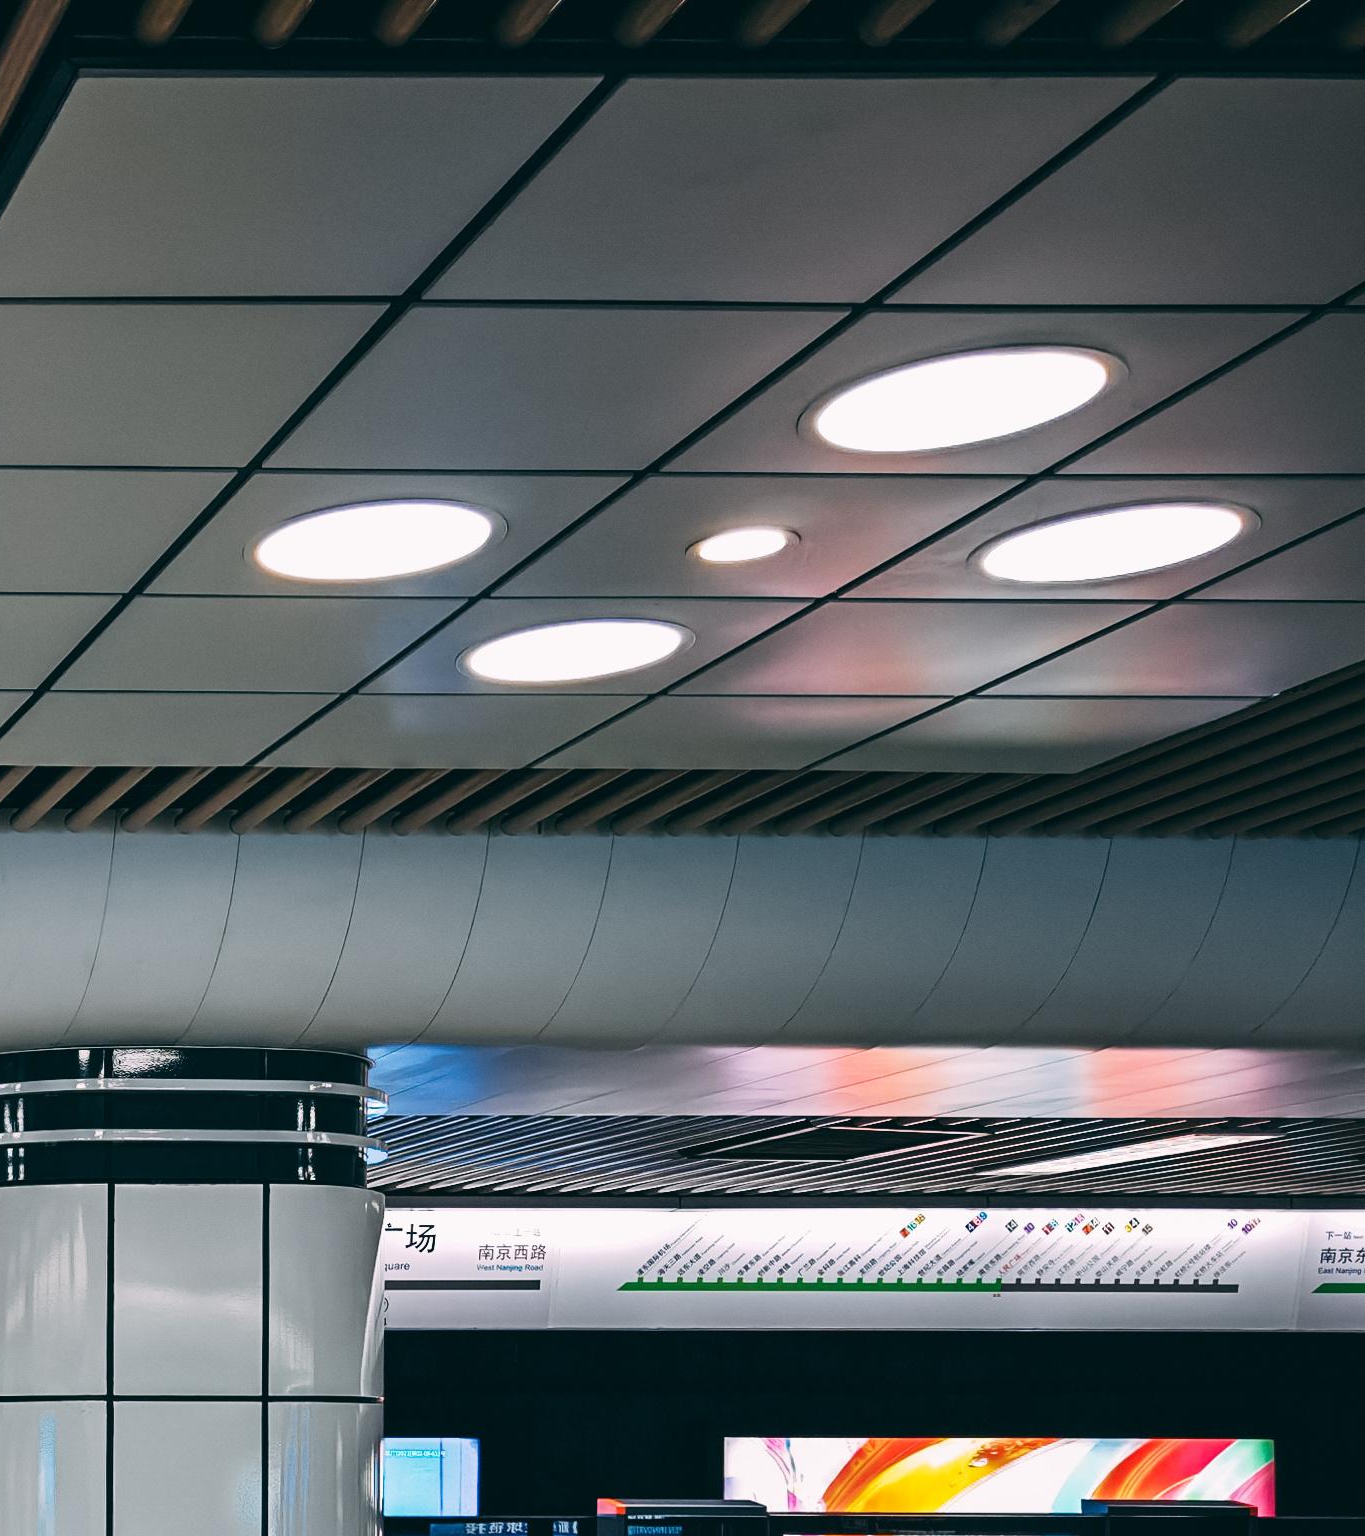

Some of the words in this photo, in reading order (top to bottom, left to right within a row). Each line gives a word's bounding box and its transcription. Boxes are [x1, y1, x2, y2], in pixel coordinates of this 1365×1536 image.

[1325, 1231, 1351, 1240] 下一站
[478, 1244, 546, 1260] 南京西路
[497, 1264, 523, 1273] Nanjing
[1318, 1267, 1333, 1275] East
[1335, 1267, 1362, 1276] Nanjing
